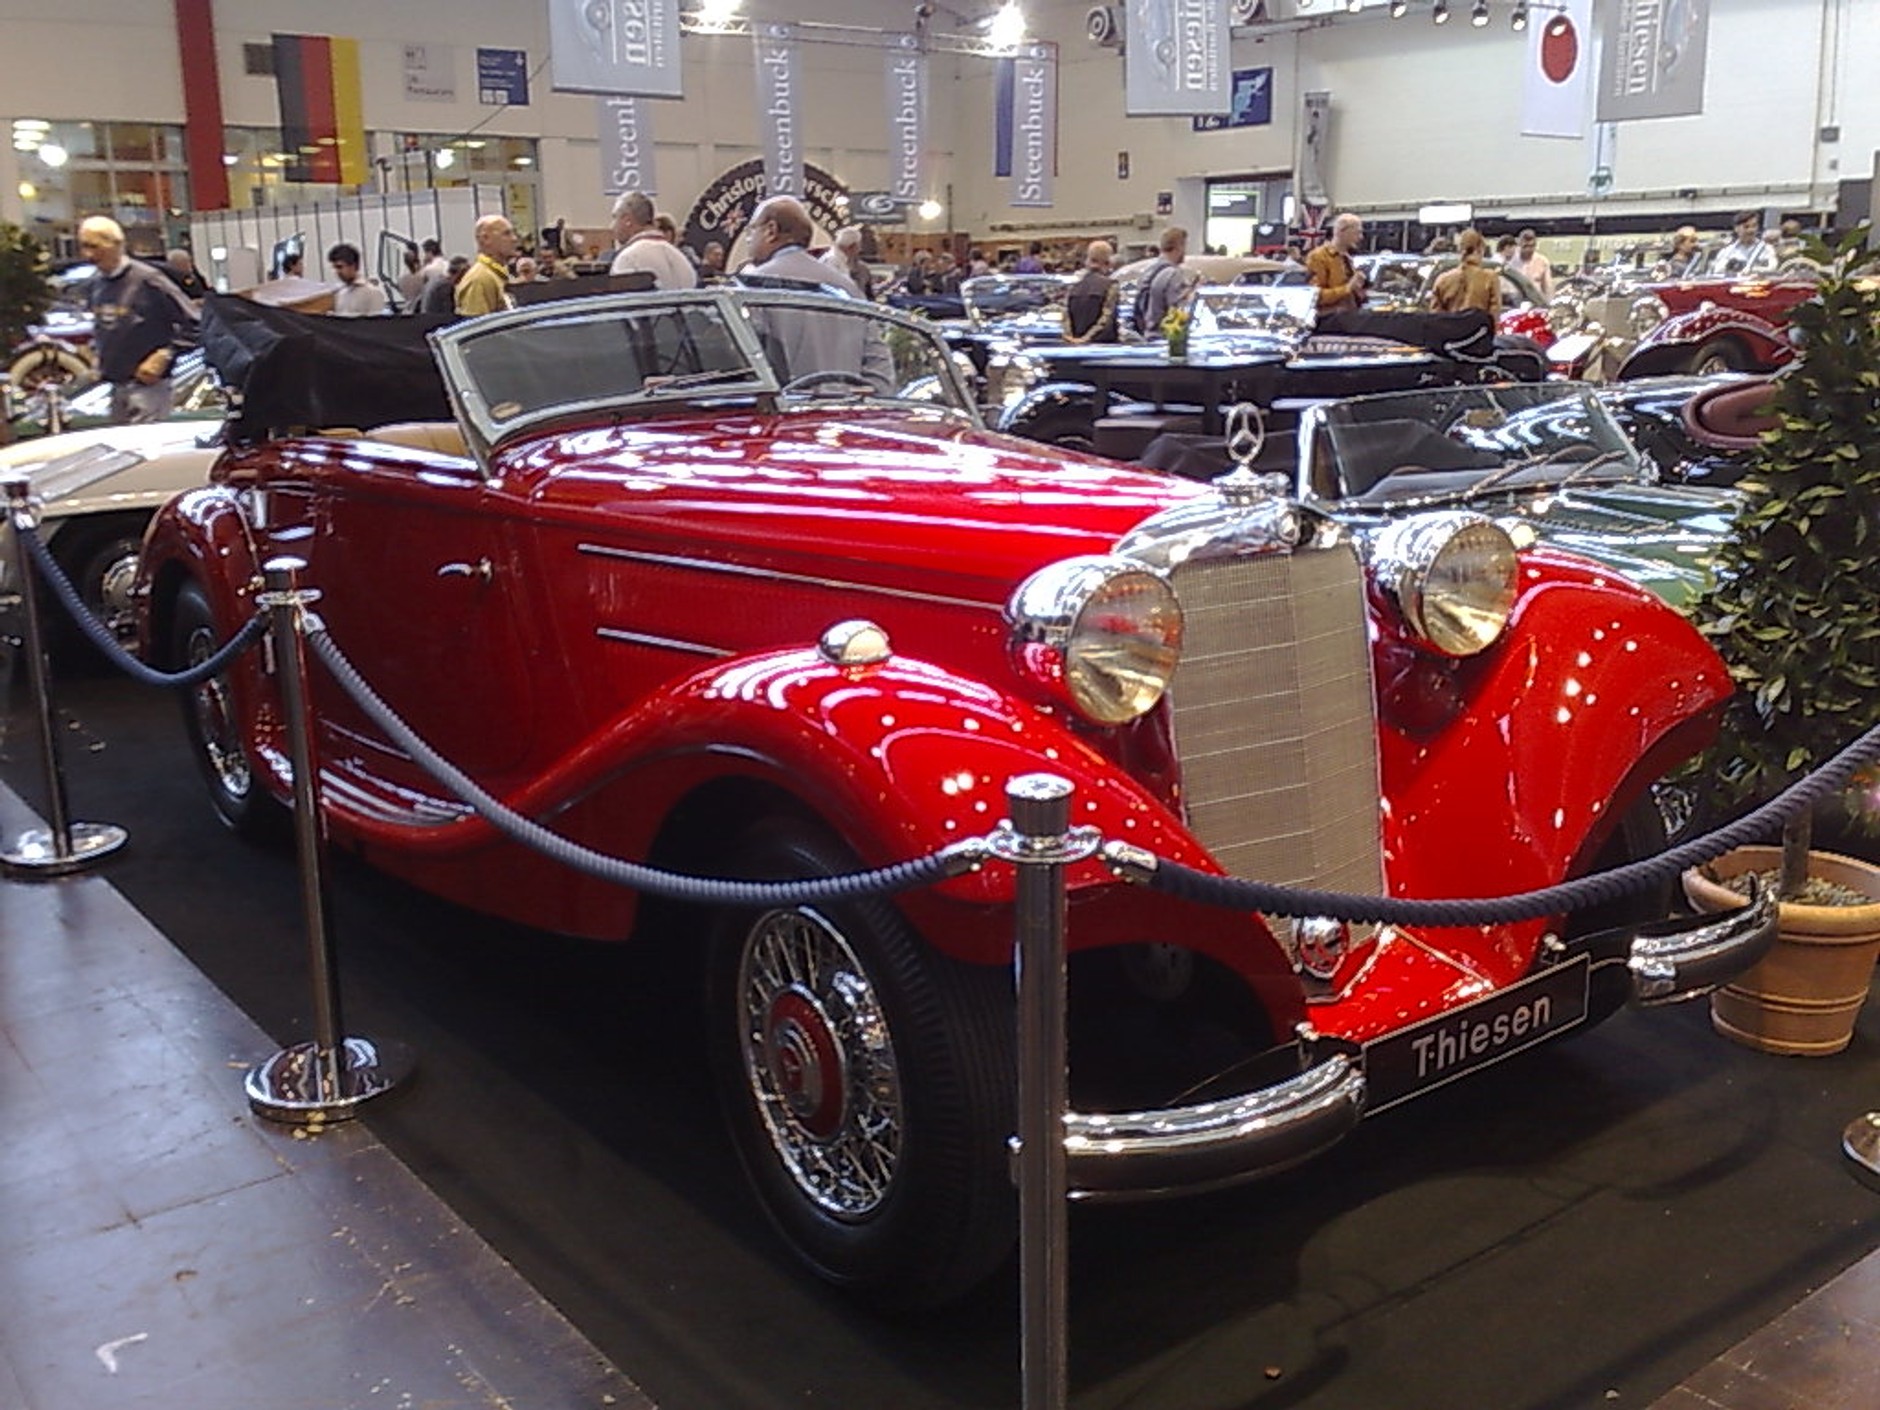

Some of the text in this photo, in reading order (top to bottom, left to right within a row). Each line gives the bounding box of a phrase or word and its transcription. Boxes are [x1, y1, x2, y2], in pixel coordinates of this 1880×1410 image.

[763, 49, 793, 192] Steenbuck
[894, 59, 918, 197] Steenbuck
[1018, 68, 1045, 201] Steenbuck
[700, 173, 765, 230] Christop
[1411, 996, 1552, 1078] Thiesen
